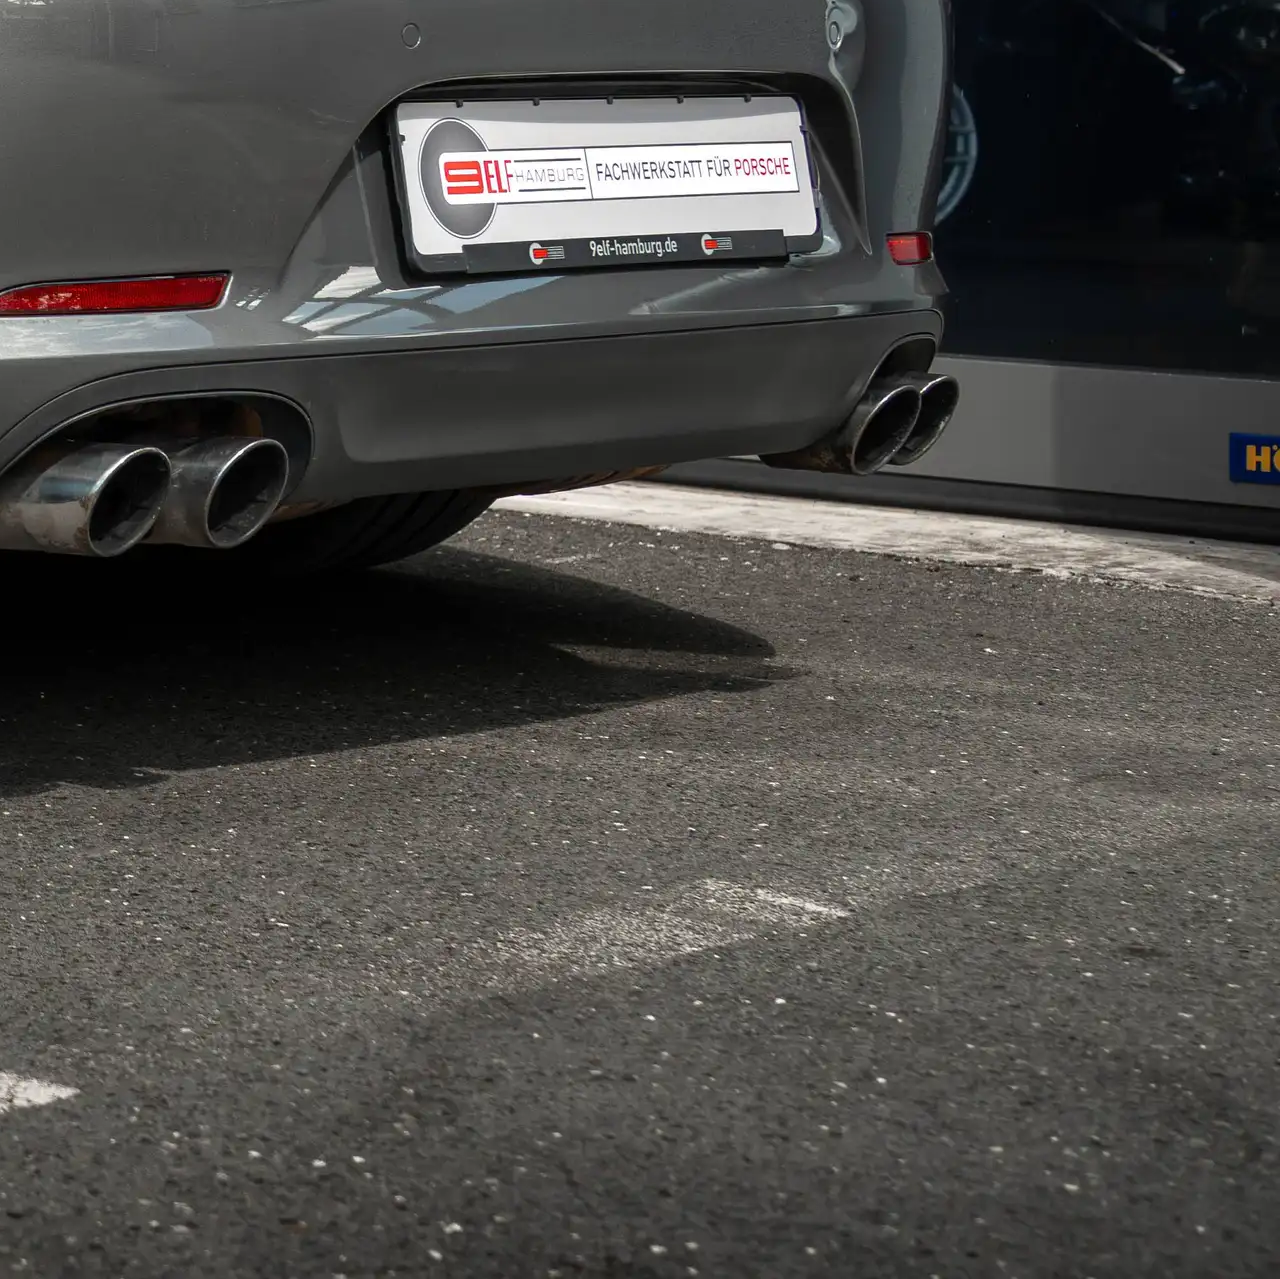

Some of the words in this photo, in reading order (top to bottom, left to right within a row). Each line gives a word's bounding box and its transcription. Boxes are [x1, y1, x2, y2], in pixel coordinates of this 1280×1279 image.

[515, 166, 586, 185] HAMBURG
[596, 160, 705, 181] FACHWERKSTATT
[706, 155, 733, 178] FÜR
[734, 156, 791, 177] PORSCHE
[589, 237, 679, 258] 9elf-hamburg.de
[1246, 444, 1280, 473] H
